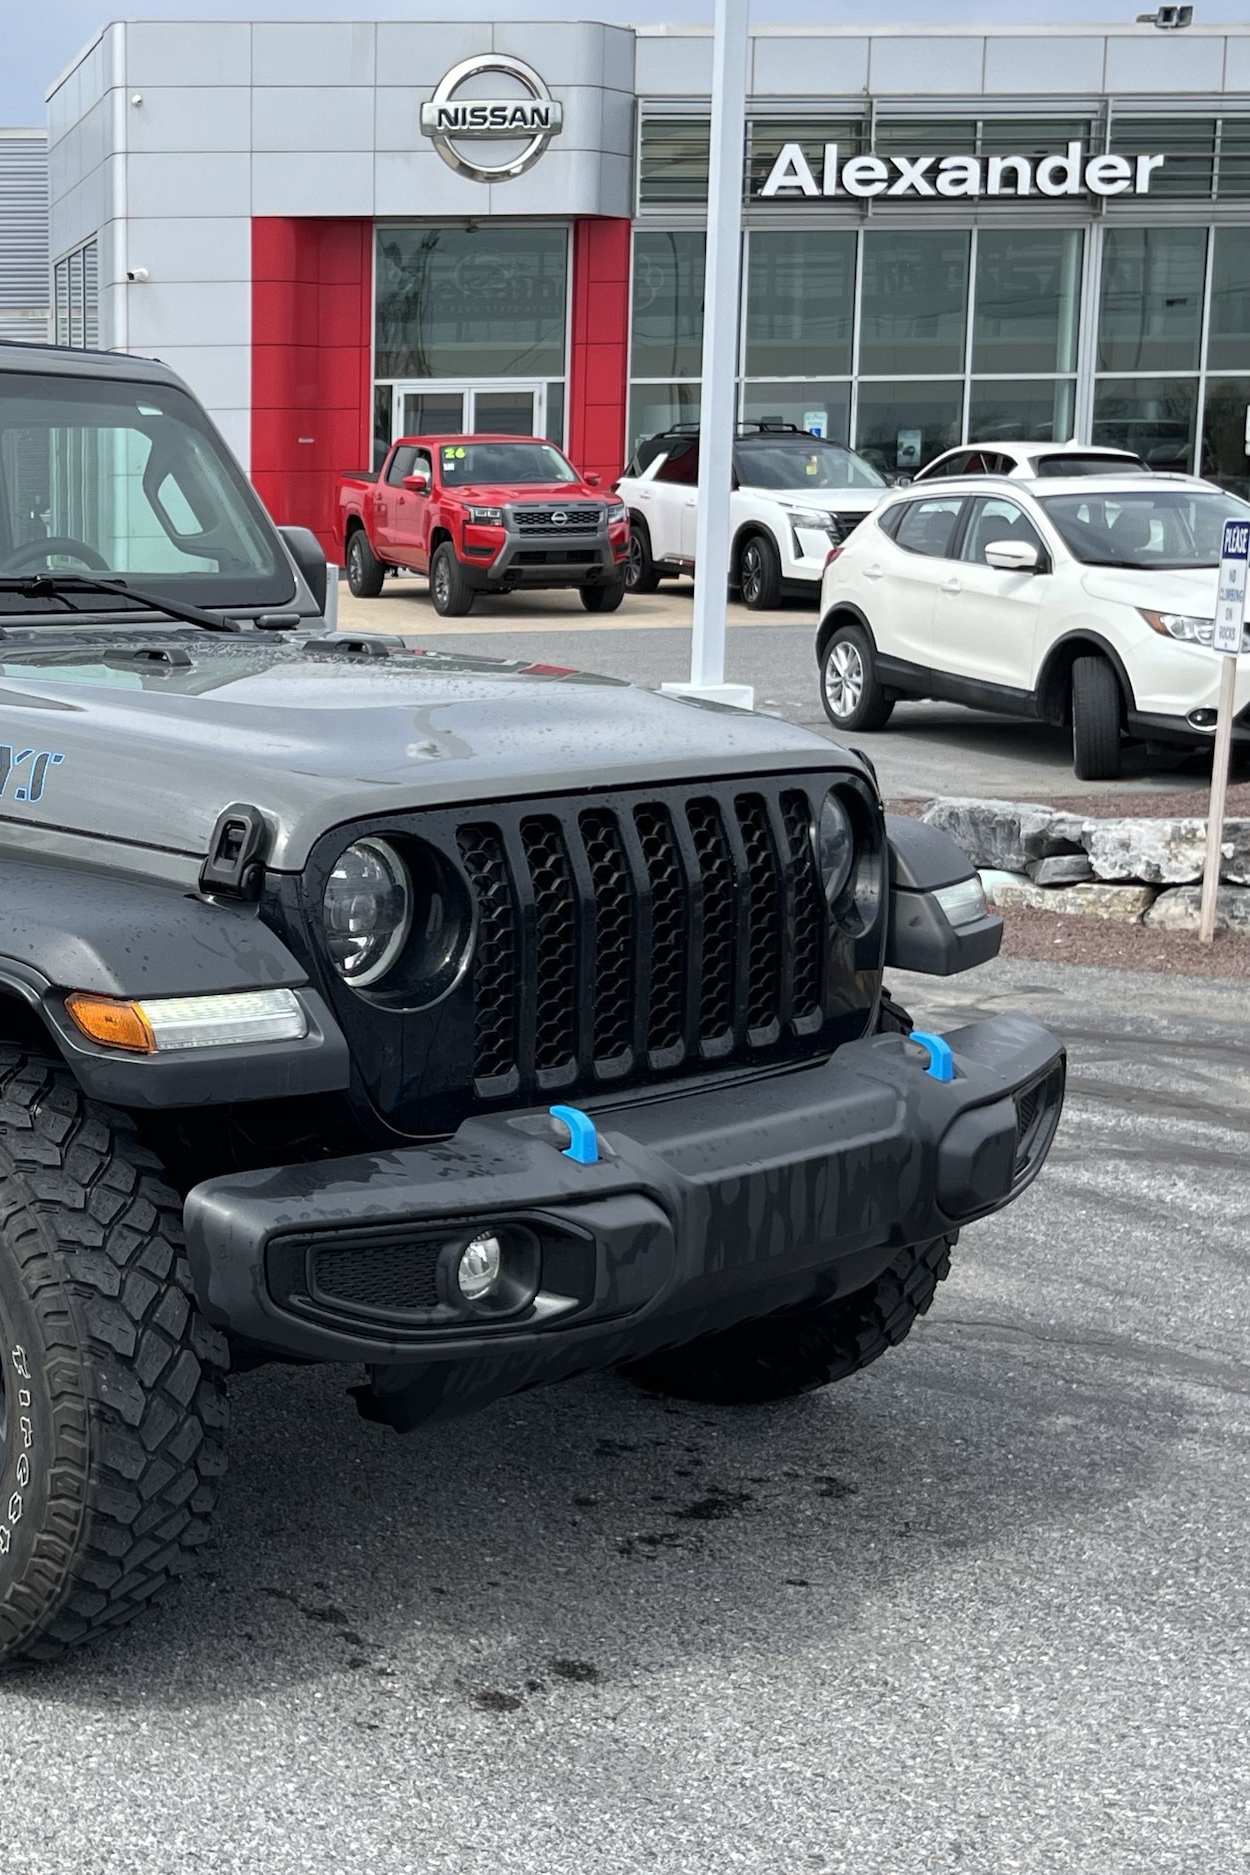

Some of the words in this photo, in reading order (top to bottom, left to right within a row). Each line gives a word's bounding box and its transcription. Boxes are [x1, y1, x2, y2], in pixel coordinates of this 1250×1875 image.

[436, 106, 553, 129] NISSAN
[762, 142, 1164, 197] Alexander
[444, 448, 465, 459] 26
[1225, 528, 1248, 553] PLEASE
[1220, 626, 1235, 641] ROCKS
